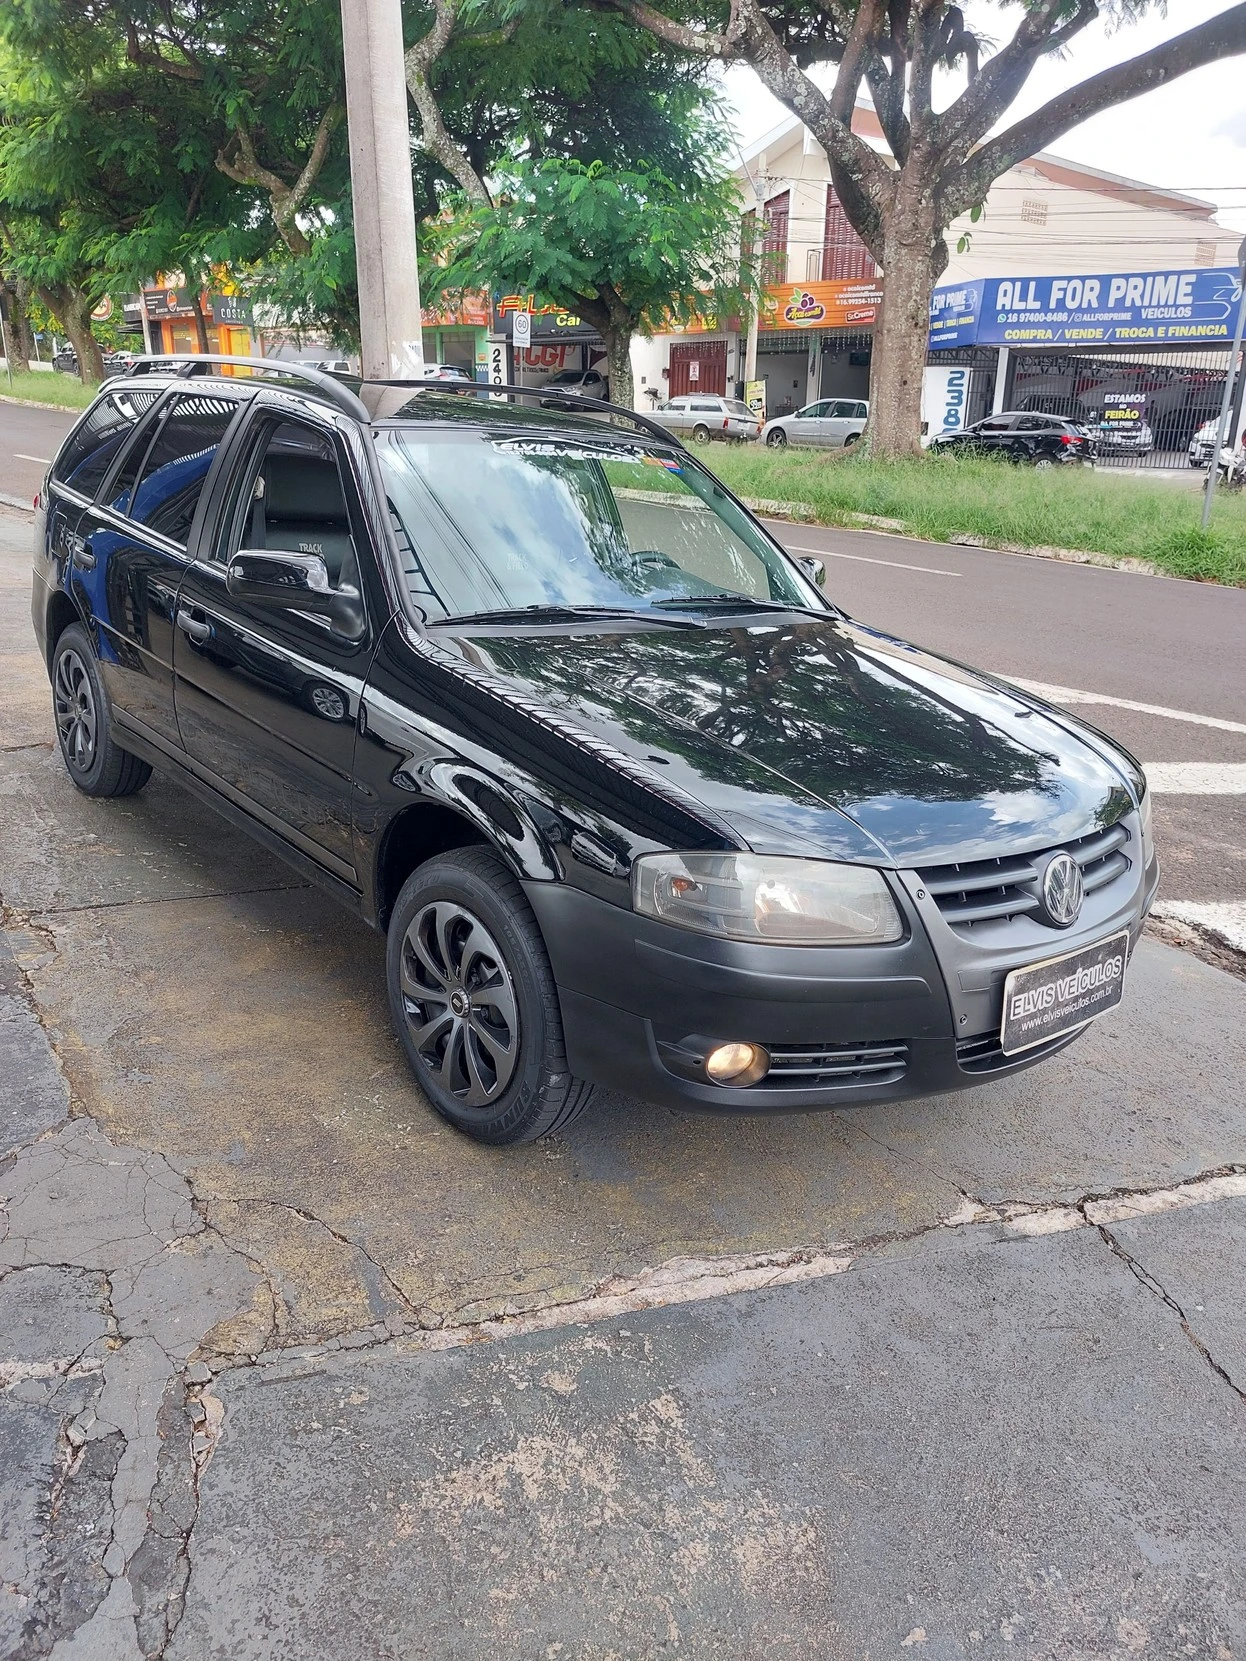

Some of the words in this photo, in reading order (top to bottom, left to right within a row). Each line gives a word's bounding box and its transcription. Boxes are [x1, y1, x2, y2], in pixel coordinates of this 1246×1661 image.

[996, 281, 1041, 310] ALL
[1049, 279, 1101, 310] FOR
[1107, 274, 1197, 308] PRIME
[220, 308, 246, 319] COSTA
[1007, 313, 1018, 323] 16
[1082, 312, 1132, 322] ALLFORPRIME
[1141, 306, 1192, 319] VEICULOS
[517, 319, 527, 328] 60
[1004, 329, 1053, 340] COMPRA
[1064, 328, 1104, 339] VENDE
[1115, 327, 1154, 338] TROCA
[1157, 327, 1165, 337] E
[1168, 325, 1228, 337] FINANCIA
[943, 370, 965, 433] 238
[1104, 394, 1146, 403] ESTAMOS
[1105, 408, 1140, 419] FEIRÃO
[500, 443, 556, 451] ELVIS
[299, 542, 323, 553] TRACK
[1010, 983, 1056, 1021] ELVIS
[1056, 955, 1123, 1002] VEÍCULOS
[1021, 985, 1113, 1032] www.elvisveiculos.com.br
